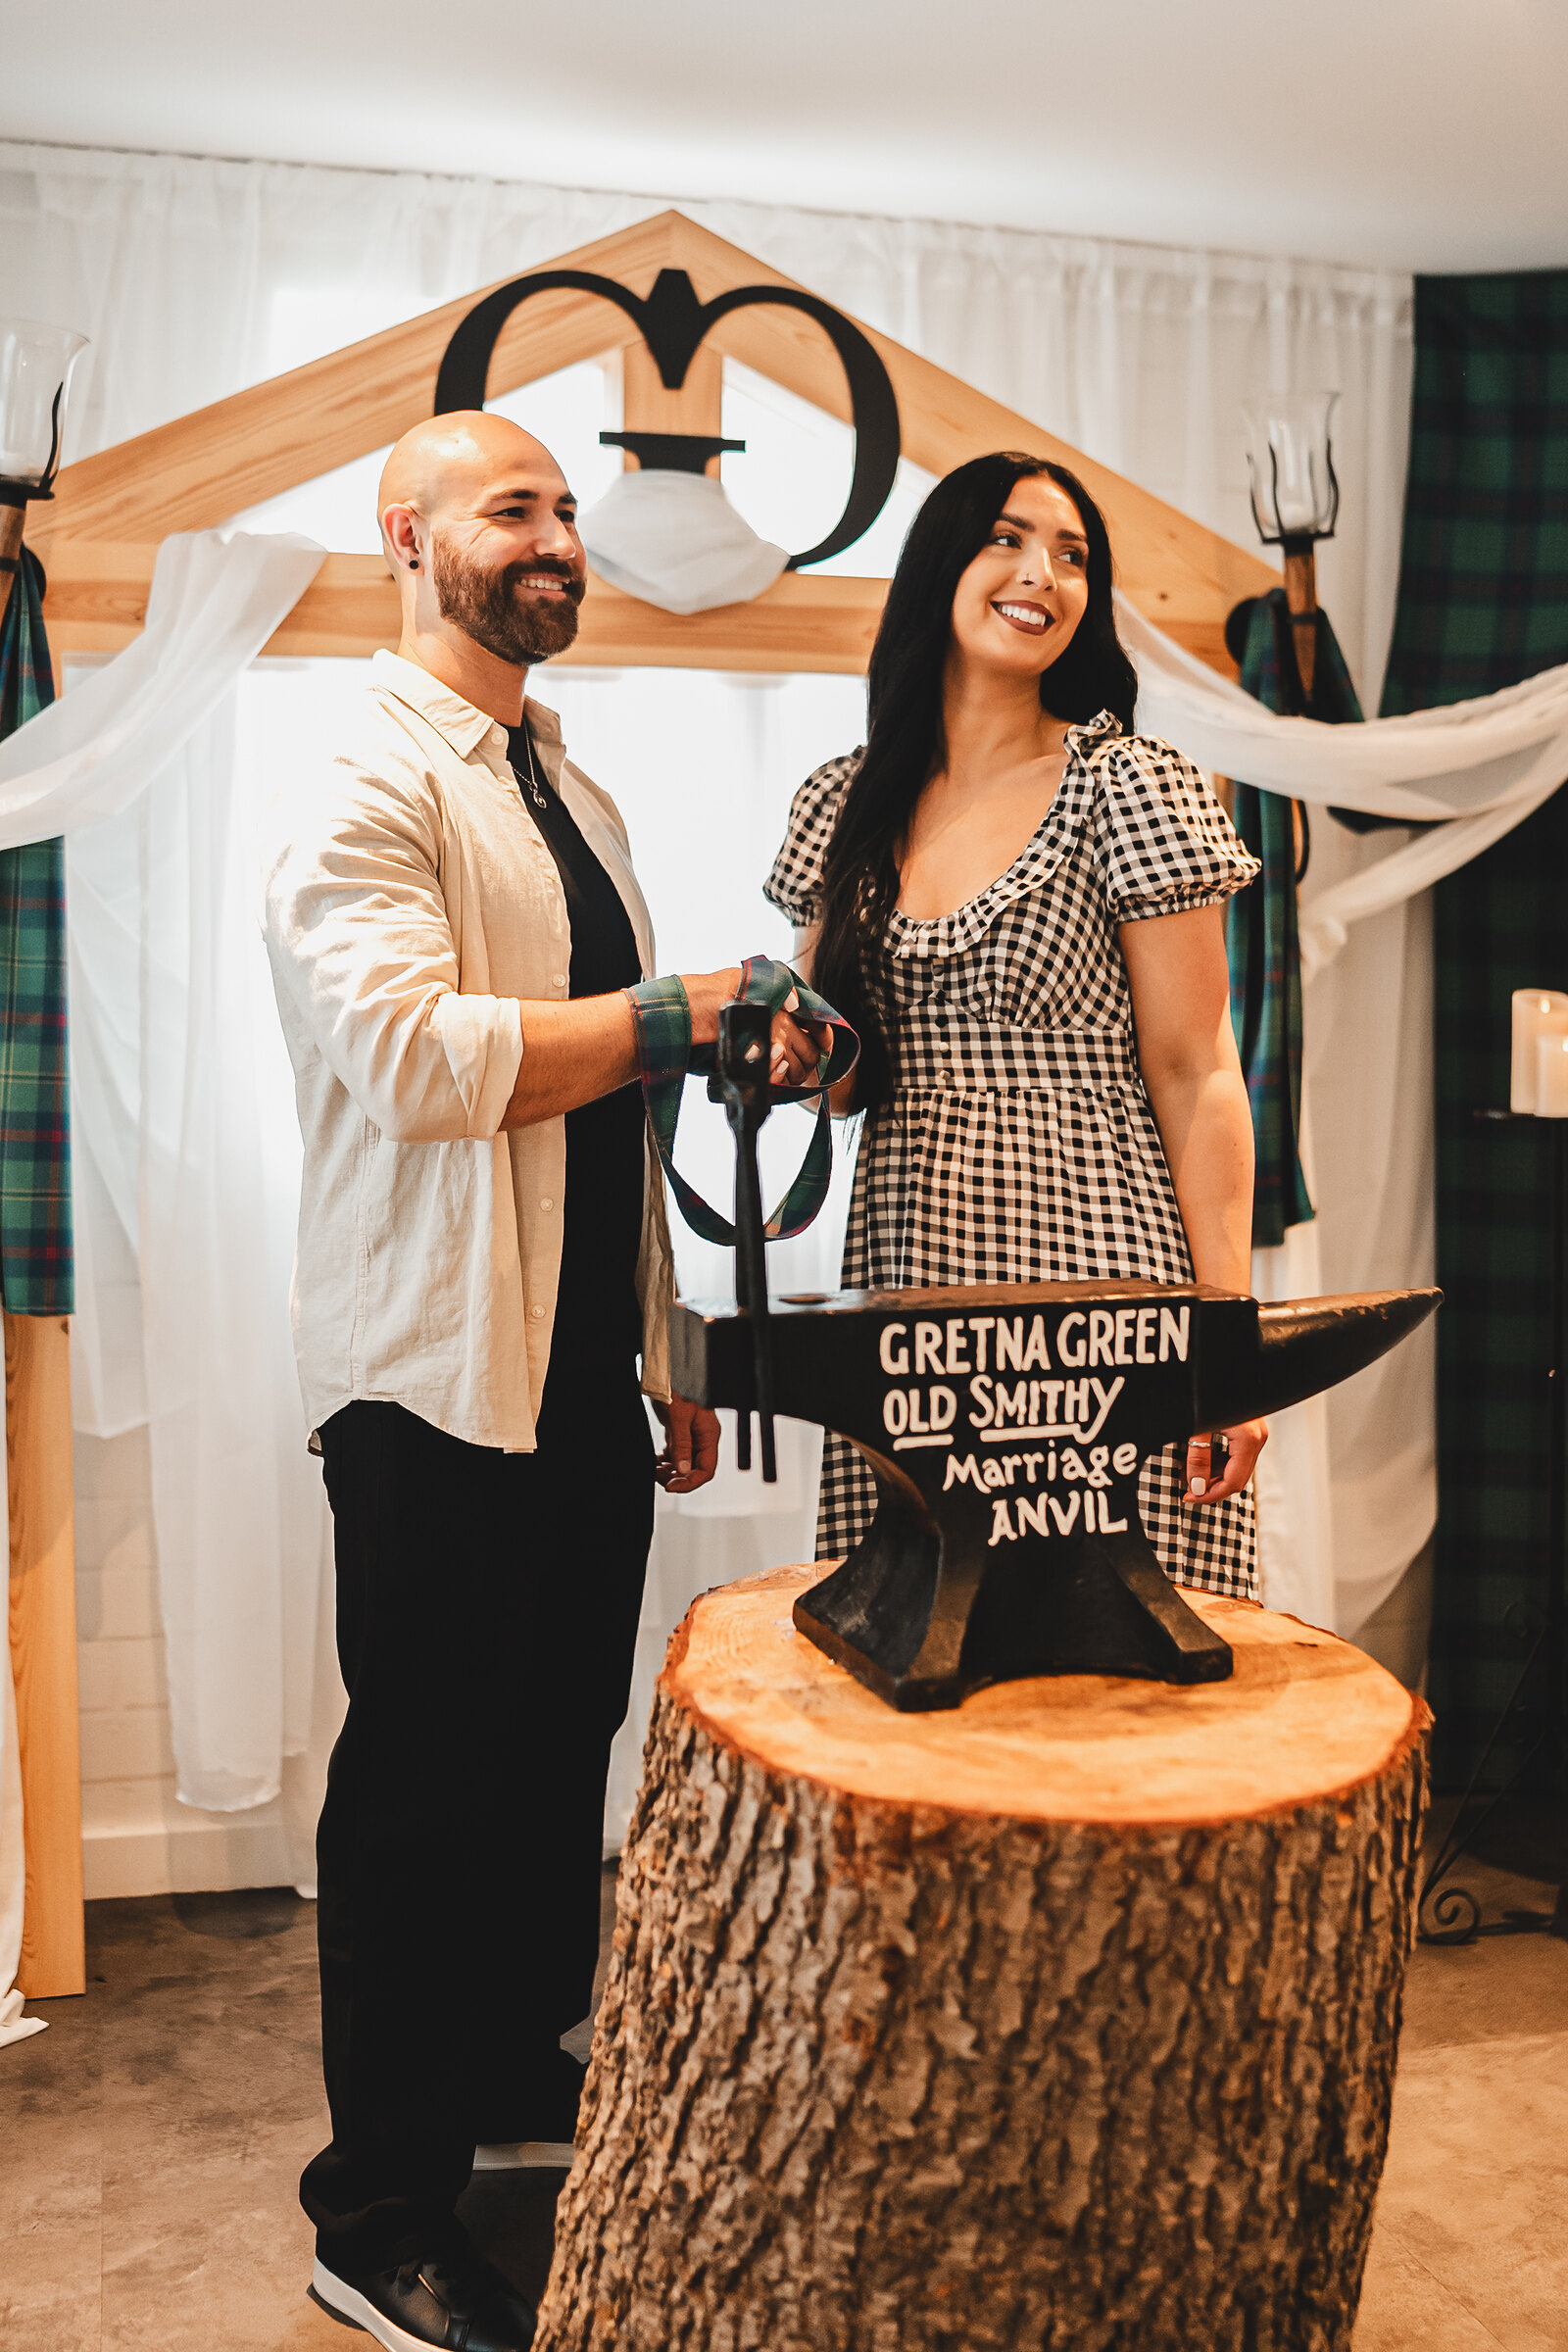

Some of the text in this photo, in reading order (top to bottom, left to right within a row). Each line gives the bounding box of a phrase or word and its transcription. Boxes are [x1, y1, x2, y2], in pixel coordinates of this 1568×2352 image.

[879, 1305, 1191, 1375] GRETNA GREEN
[883, 1384, 957, 1437] OLD
[942, 1440, 1138, 1494] Marriage
[987, 1490, 1129, 1546] ANVIL
